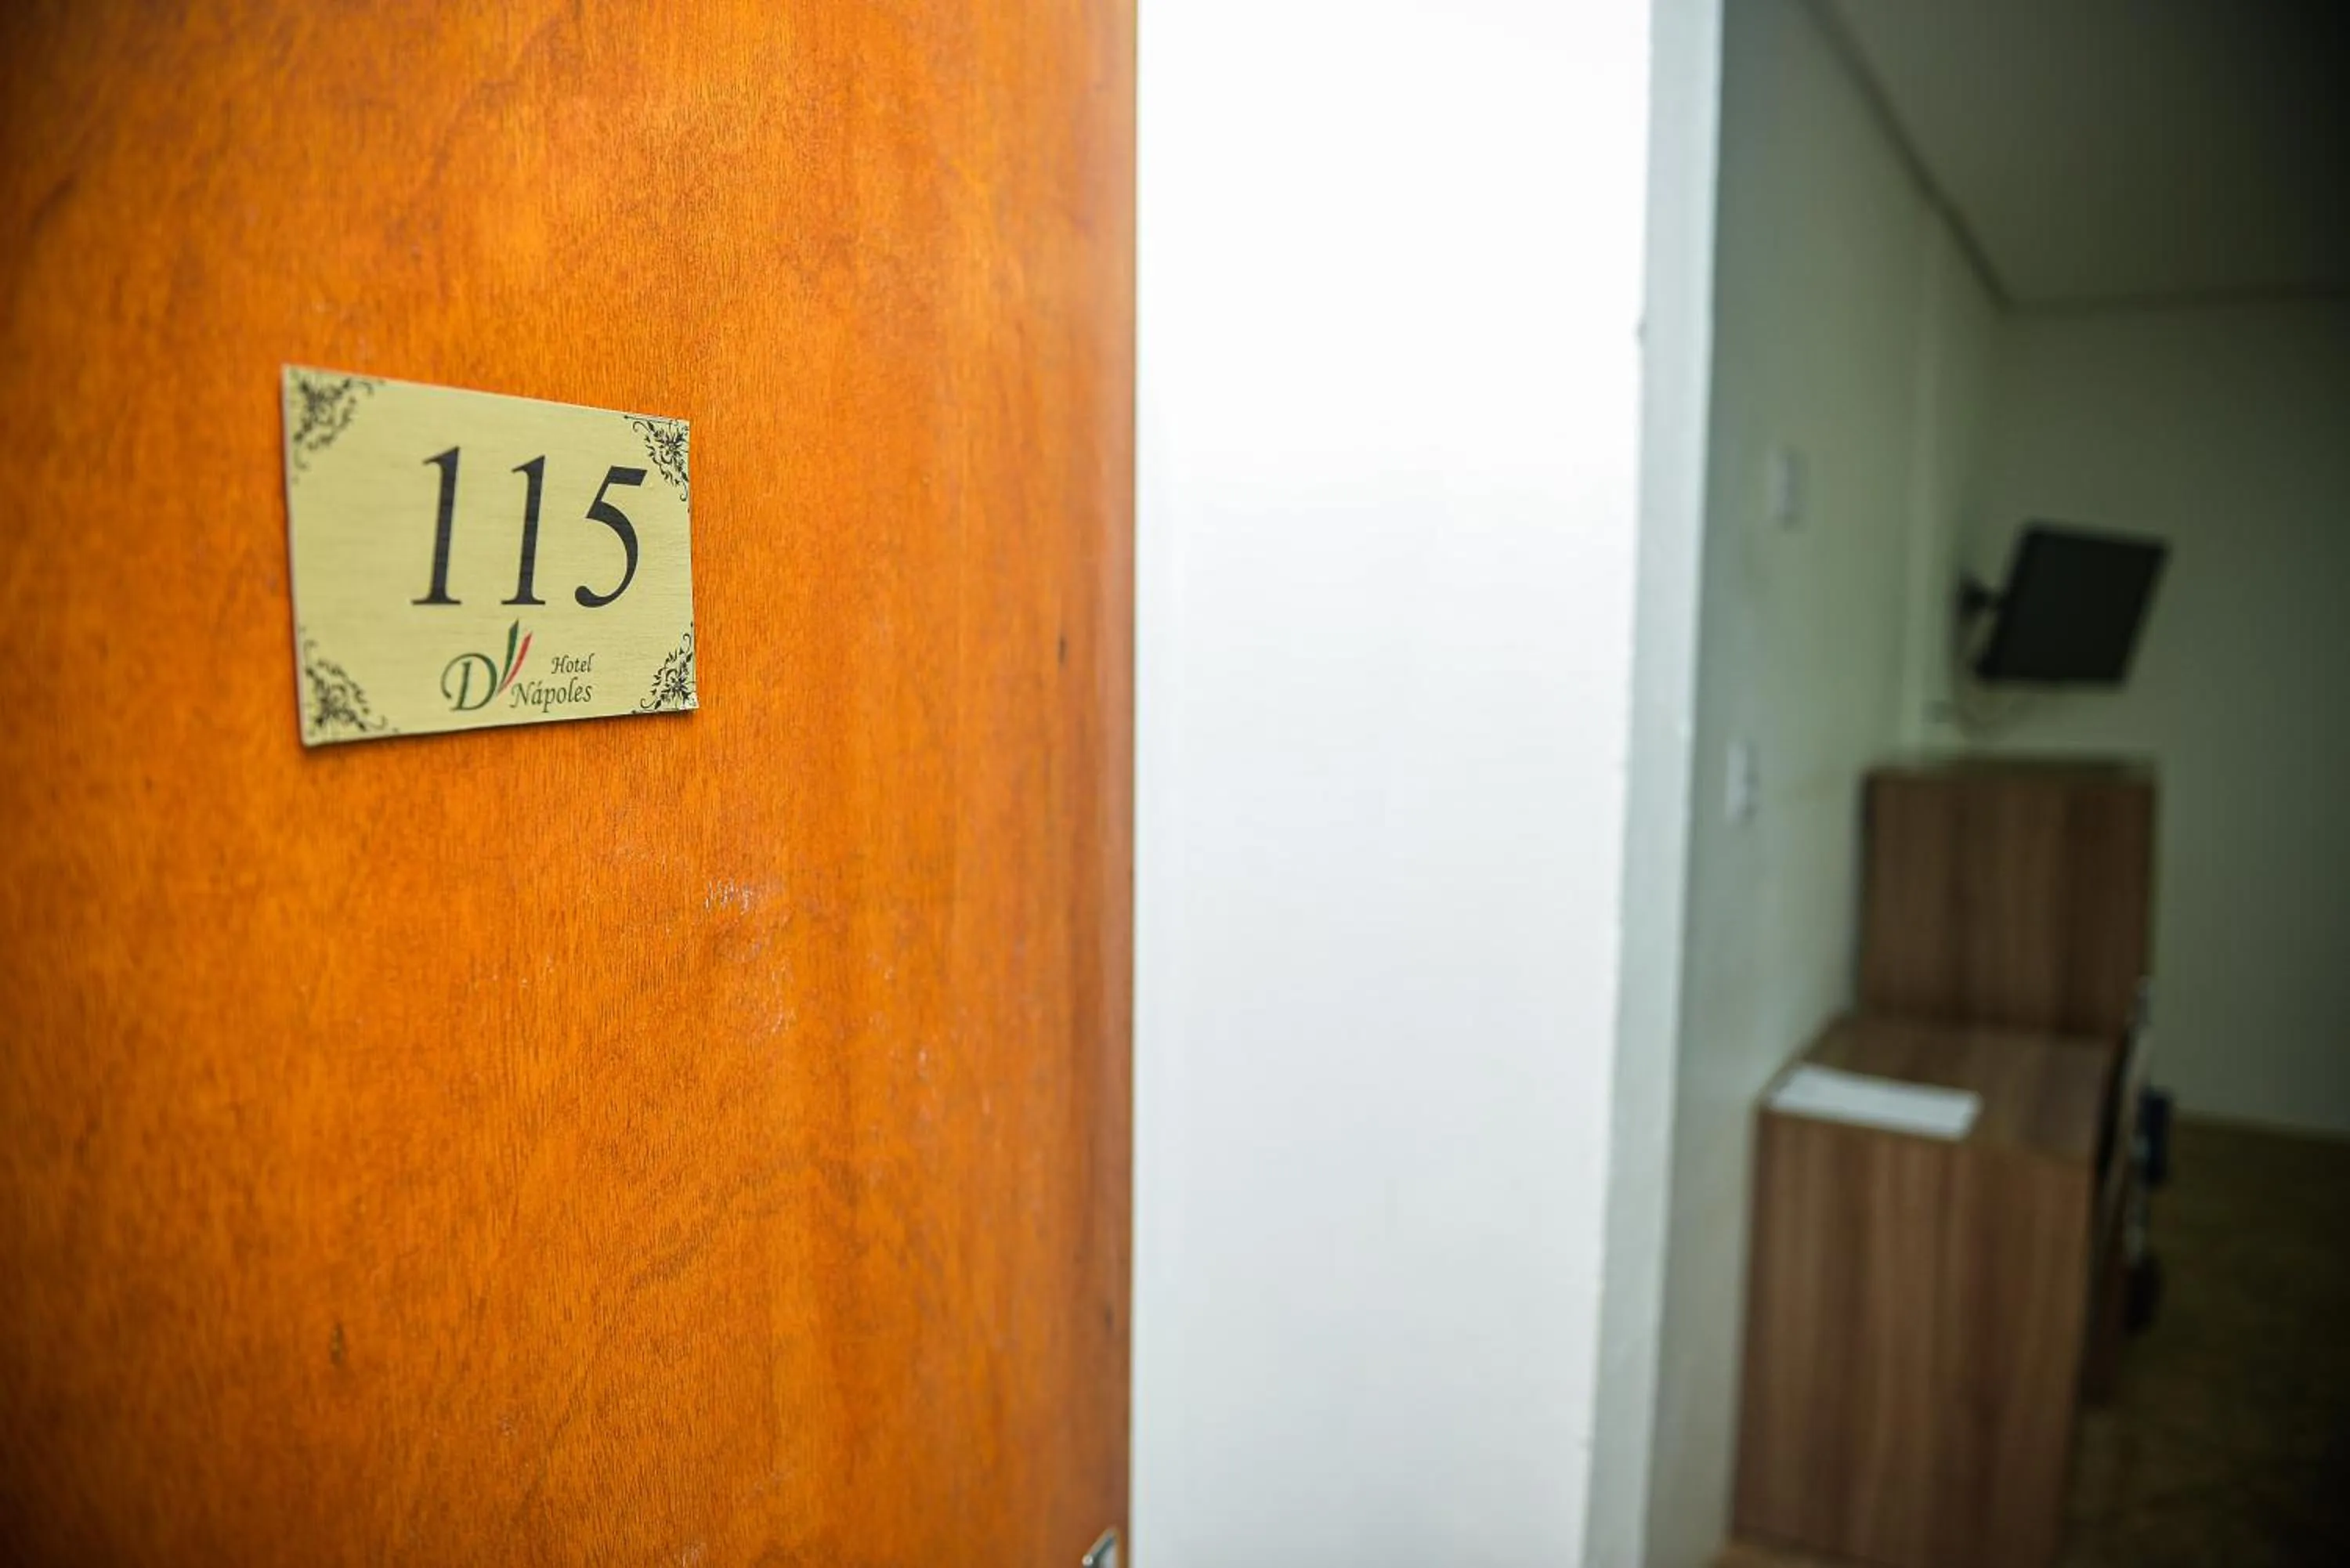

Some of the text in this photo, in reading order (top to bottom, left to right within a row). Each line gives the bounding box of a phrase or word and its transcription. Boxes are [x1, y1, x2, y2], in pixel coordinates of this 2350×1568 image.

[411, 446, 648, 609] 115
[551, 653, 595, 674] Hotel
[509, 677, 593, 714] Nápoles
